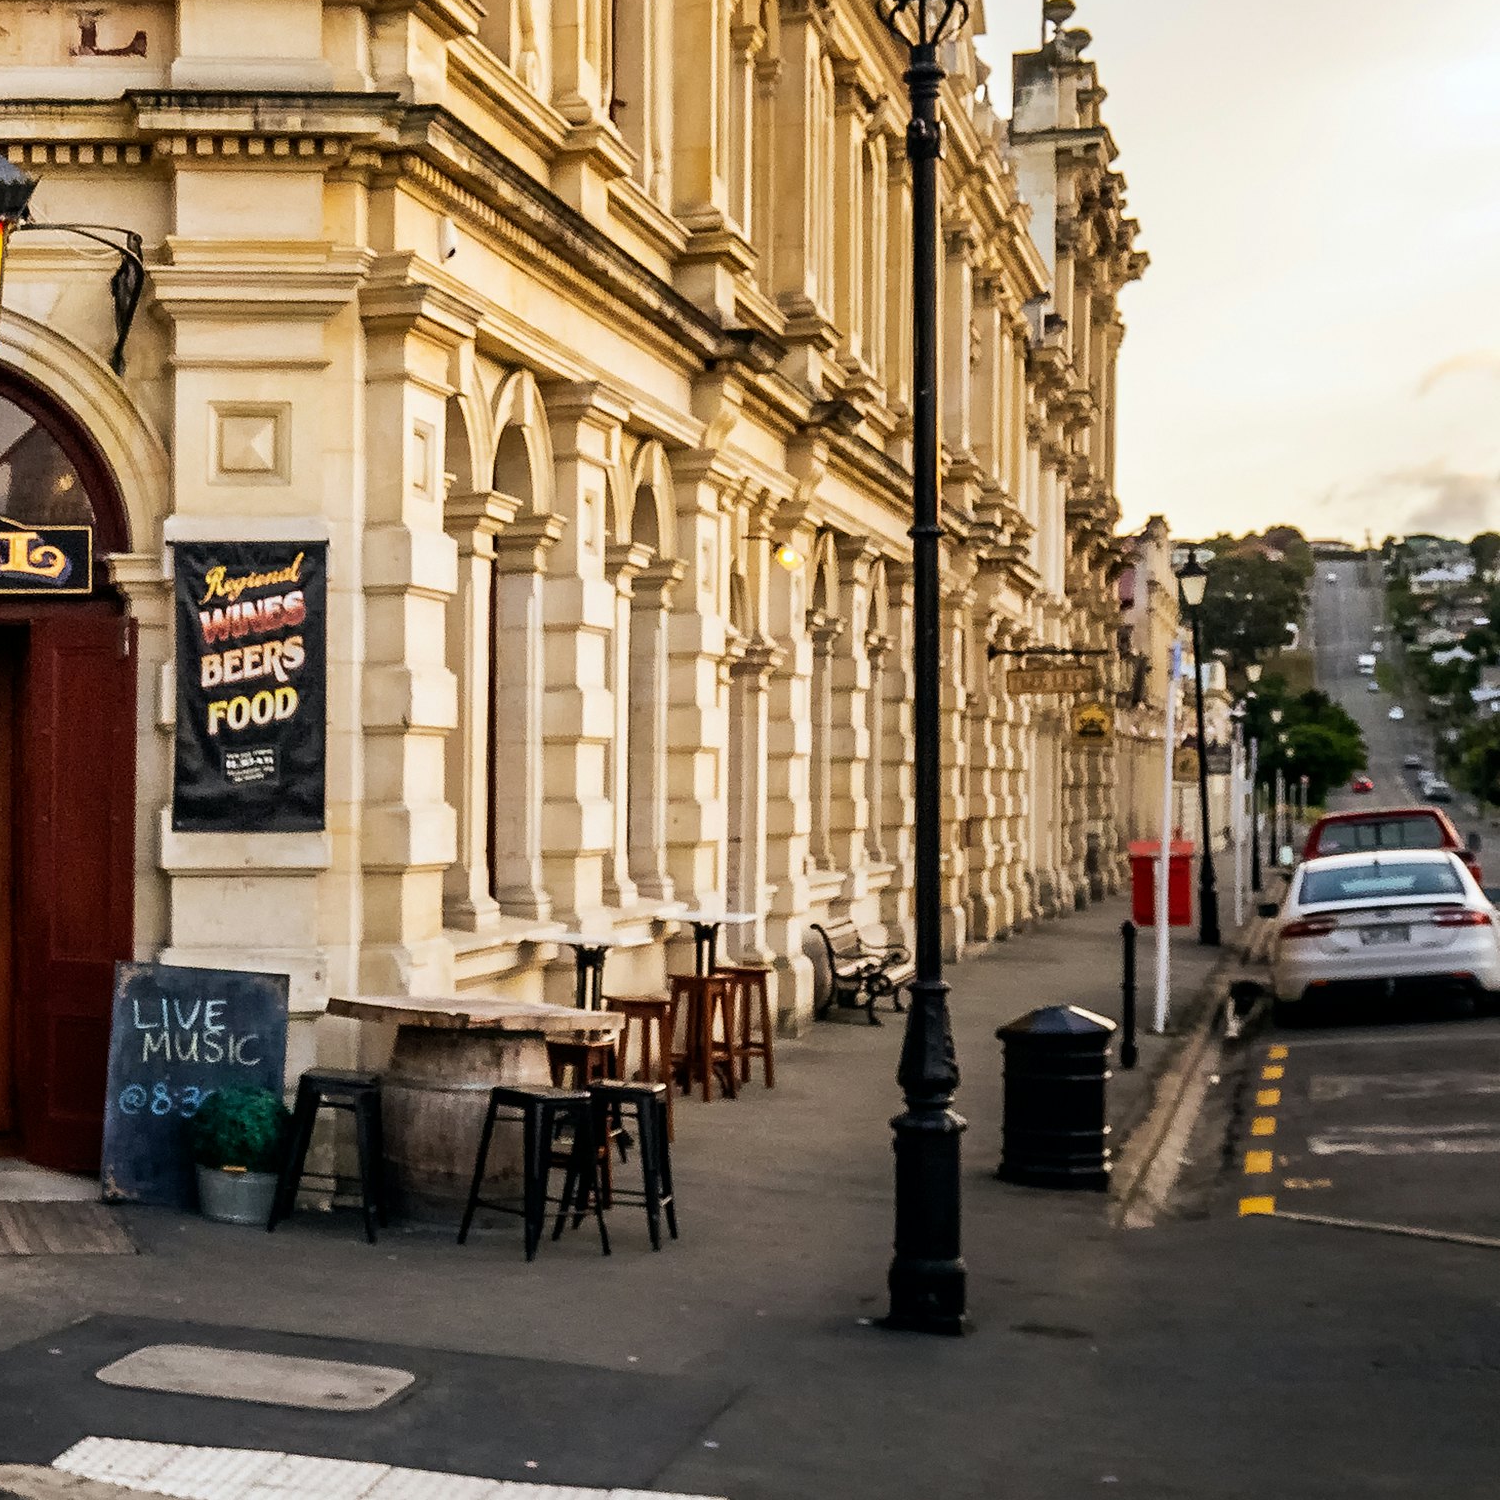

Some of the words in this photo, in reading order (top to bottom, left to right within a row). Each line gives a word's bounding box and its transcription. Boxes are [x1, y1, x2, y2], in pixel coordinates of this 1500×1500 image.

[201, 552, 304, 605] Regional
[200, 590, 307, 643] WINES
[201, 635, 305, 688] BEERS
[208, 687, 299, 734] FOOD
[133, 997, 227, 1032] LIVE
[142, 1030, 261, 1066] MUSIC
[118, 1082, 216, 1118] @8:3
